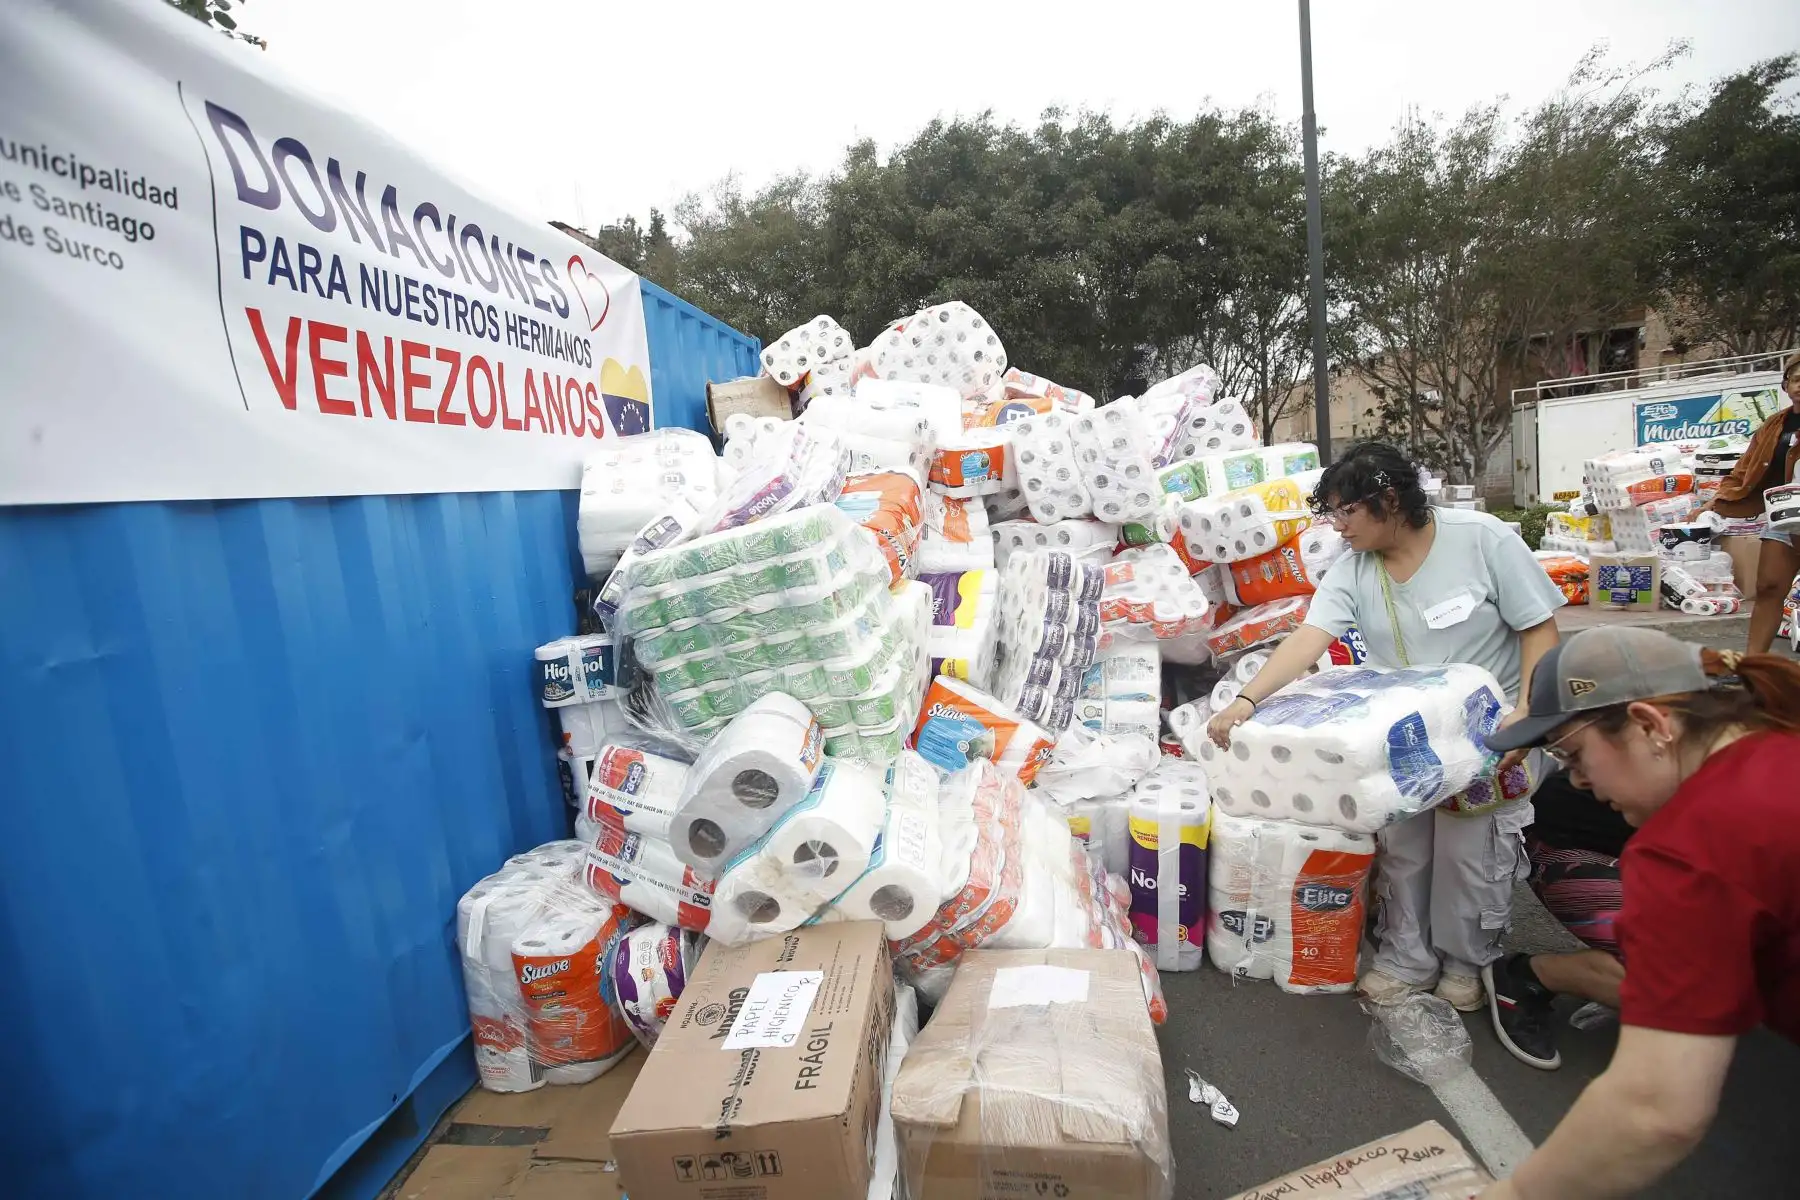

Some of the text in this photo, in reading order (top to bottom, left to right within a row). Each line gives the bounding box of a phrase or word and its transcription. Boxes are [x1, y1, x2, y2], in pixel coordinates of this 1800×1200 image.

[0, 137, 178, 210] unicipalidad
[29, 183, 155, 242] Santiago
[205, 100, 569, 319] DONACIONES
[44, 227, 124, 270] Surco
[240, 225, 592, 368] PARA NUESTROS HERMANOS
[245, 307, 604, 439] VENEZOLANOS
[1644, 420, 1749, 442] Mudanzas
[749, 493, 779, 516] Noble
[1281, 547, 1305, 584] Suave
[544, 656, 604, 682] Hignol
[928, 702, 969, 723] Suave
[1131, 869, 1187, 896] Noe
[1304, 888, 1348, 906] Elite
[1222, 914, 1271, 940] Ete
[1300, 947, 1318, 956] 40
[521, 959, 570, 984] Suave
[680, 1002, 697, 1029] PANETÓN
[736, 998, 768, 1038] PAPEL
[794, 1022, 833, 1091] FRÁGIL
